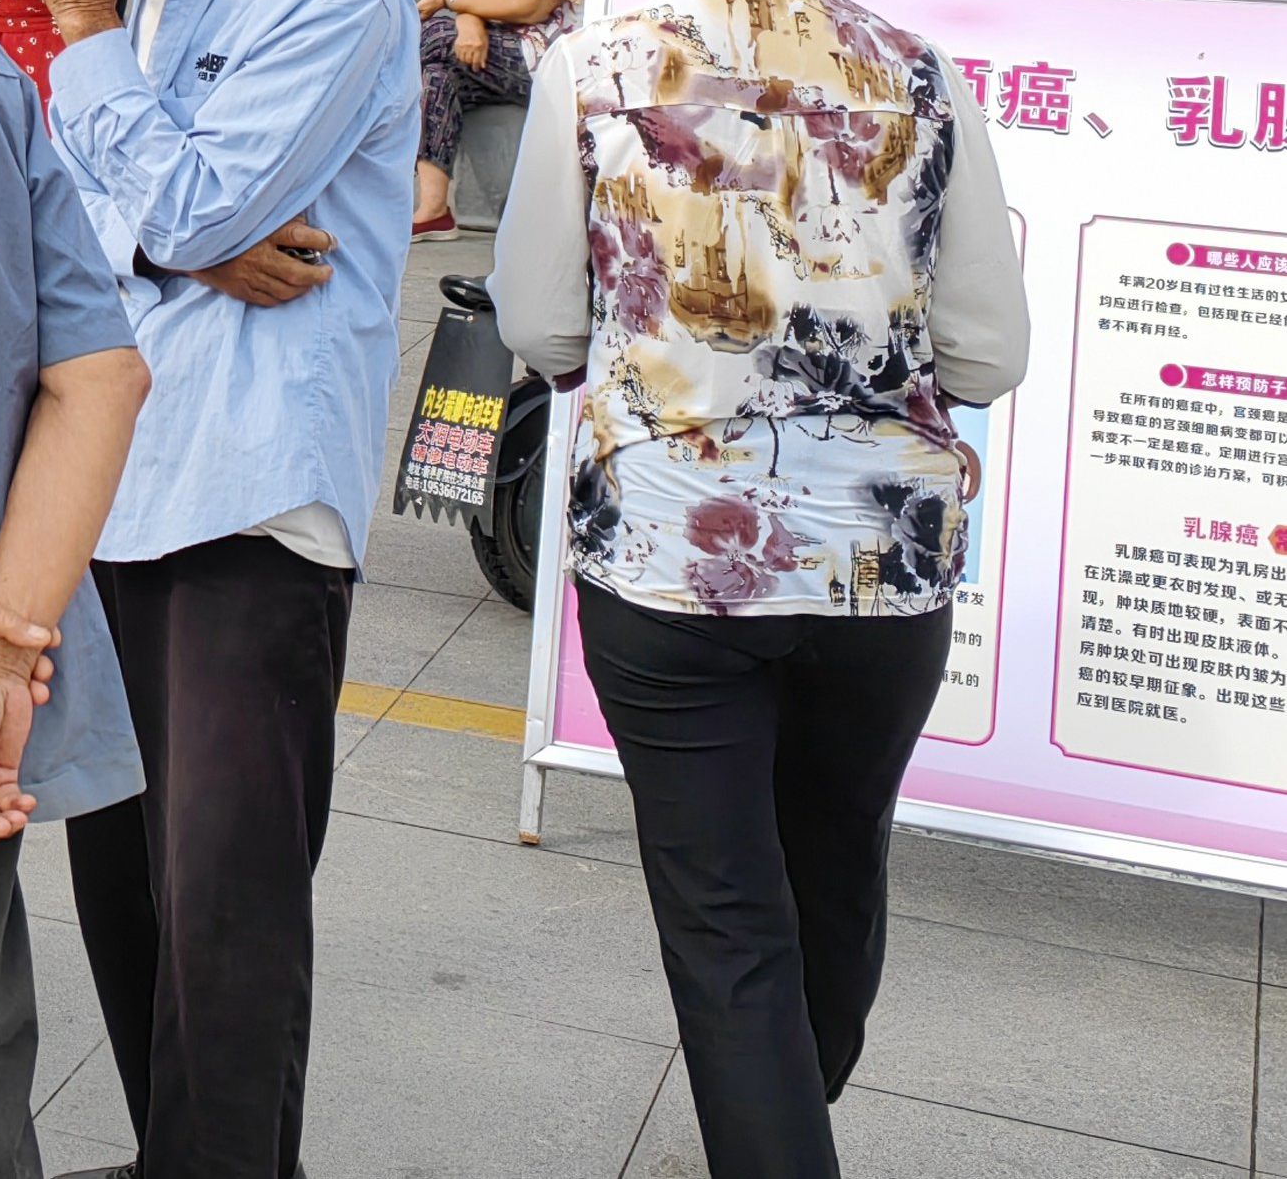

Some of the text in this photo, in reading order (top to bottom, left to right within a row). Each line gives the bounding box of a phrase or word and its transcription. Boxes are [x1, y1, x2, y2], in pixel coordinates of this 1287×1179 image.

[1097, 317, 1189, 340] 者不再有月经。
[1201, 372, 1287, 396] 怎样预防子
[1183, 516, 1260, 548] 乳腺癌
[1114, 543, 1287, 582] 乳腺癌可表现为乳房出
[1081, 614, 1280, 660] 清楚。有时出现皮肤液体。
[1076, 691, 1188, 724] 应到医院就医。
